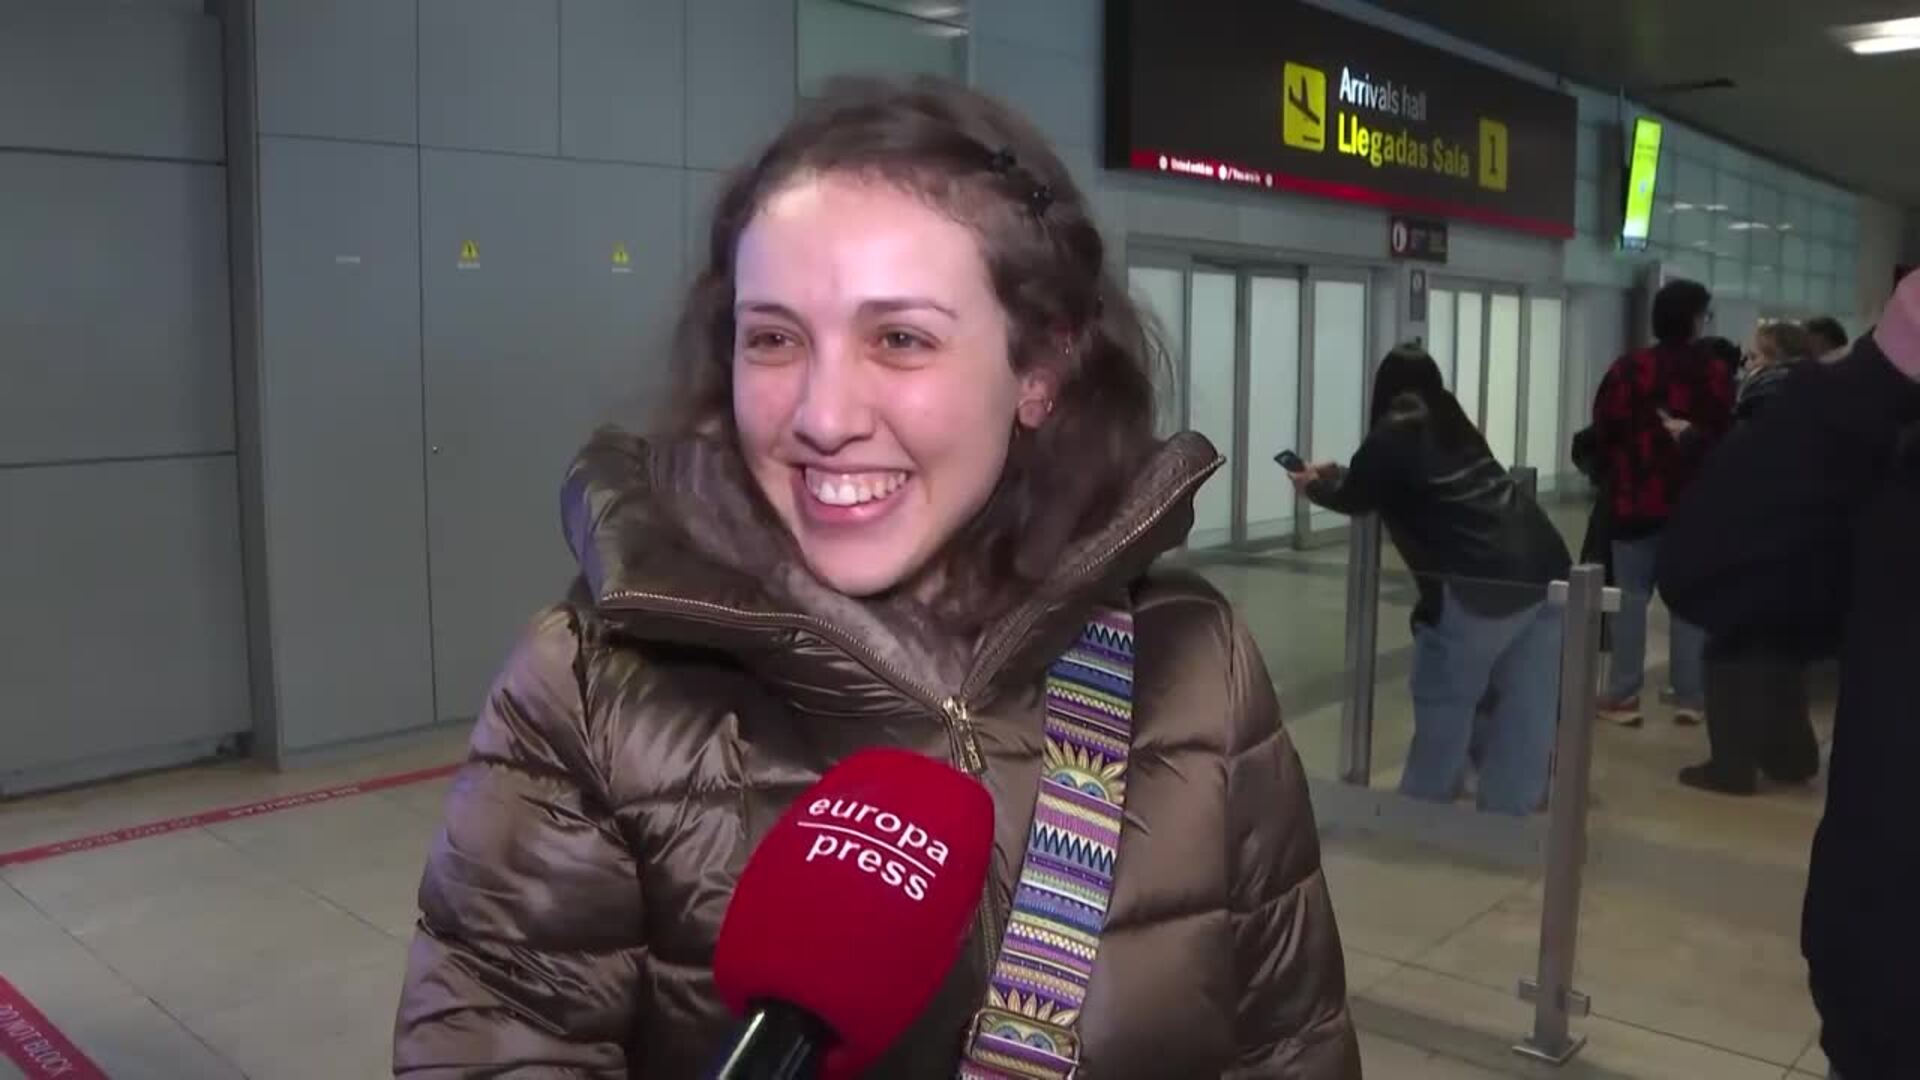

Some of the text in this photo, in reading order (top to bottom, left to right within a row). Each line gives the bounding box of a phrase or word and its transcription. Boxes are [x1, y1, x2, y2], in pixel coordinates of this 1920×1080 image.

[1339, 66, 1427, 120] Arrivals hall
[1338, 111, 1471, 178] Llegadas Sala
[1487, 134, 1498, 176] 1
[808, 798, 949, 866] europa
[806, 834, 928, 901] press
